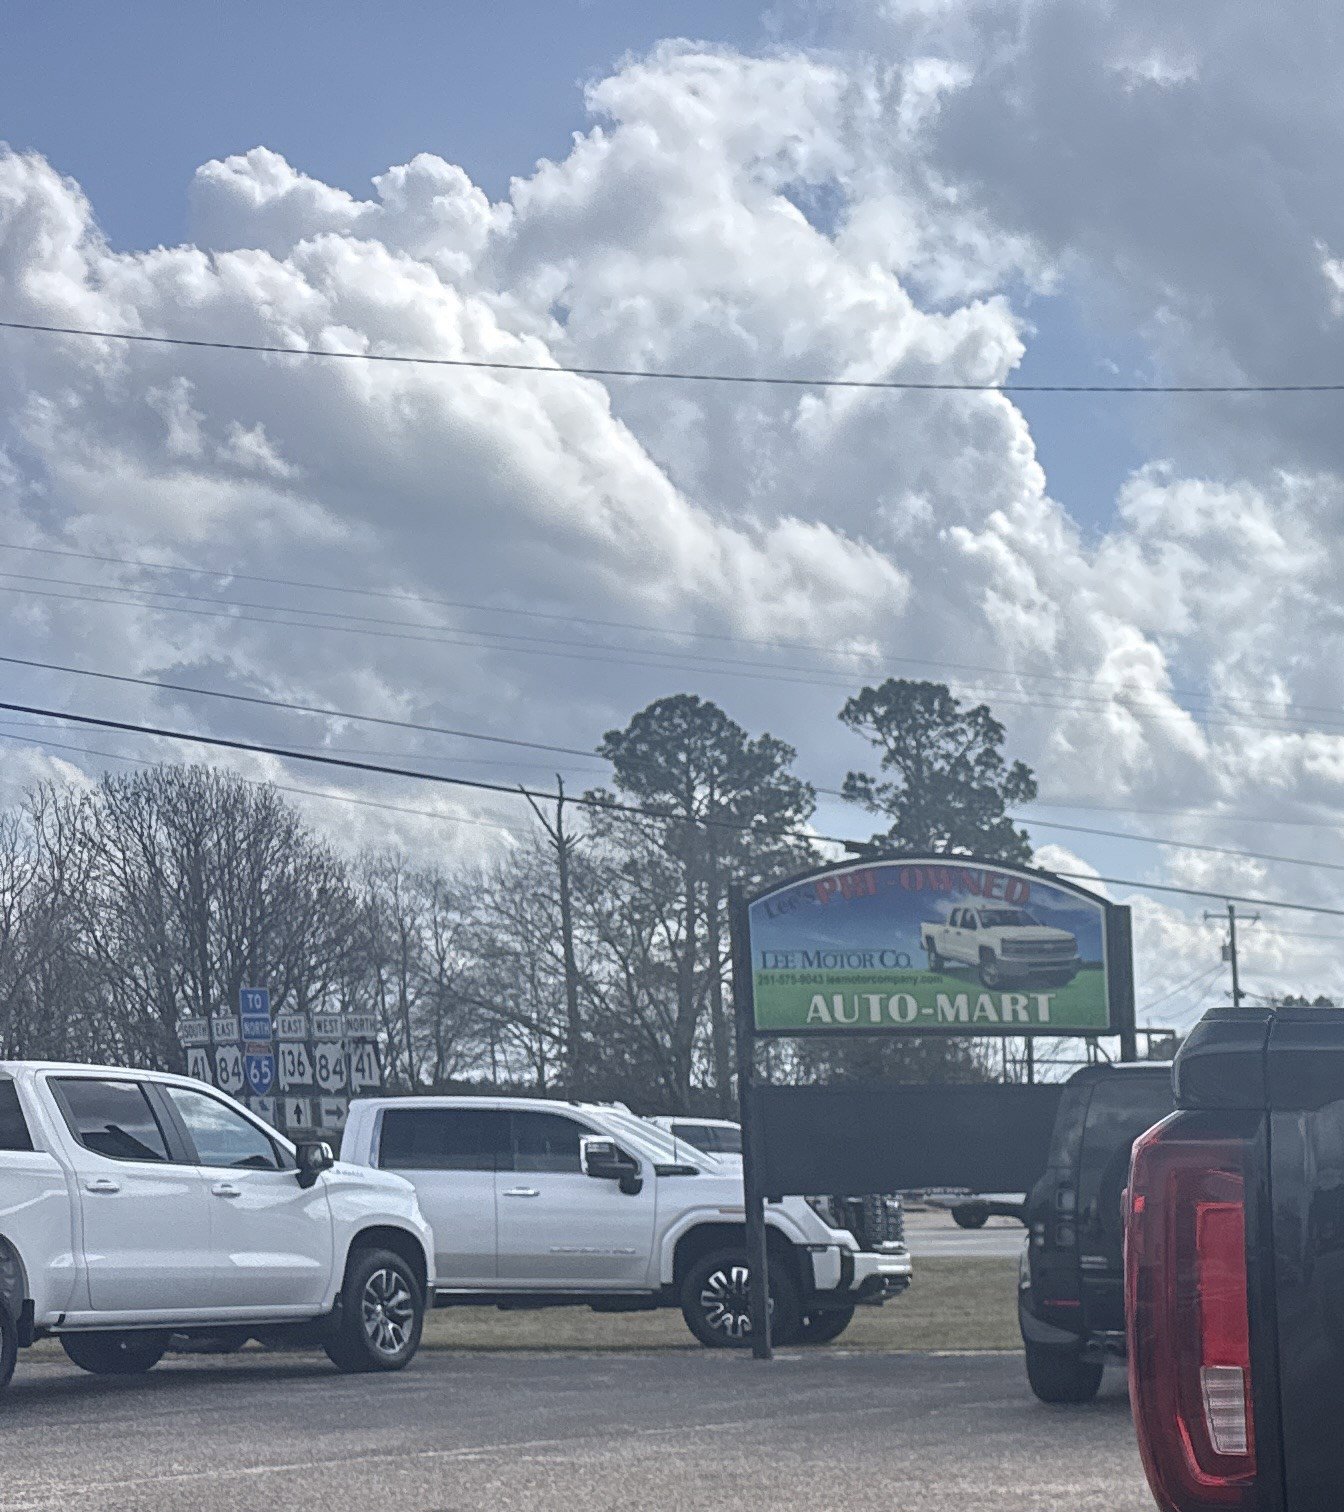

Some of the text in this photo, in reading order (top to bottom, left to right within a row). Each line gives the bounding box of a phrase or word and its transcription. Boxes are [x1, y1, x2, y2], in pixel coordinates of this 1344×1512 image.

[761, 950, 797, 970] LEE
[801, 949, 875, 970] MOTOR
[247, 993, 262, 1010] TO
[806, 993, 1056, 1024] AUTO-MART
[215, 1022, 235, 1037] EAST
[281, 1019, 303, 1034] EAST
[314, 1018, 339, 1034] WEST
[219, 1055, 242, 1085] 84
[250, 1060, 271, 1085] 65
[281, 1050, 306, 1077] 136
[319, 1054, 344, 1083] 84
[354, 1051, 373, 1081] 41
